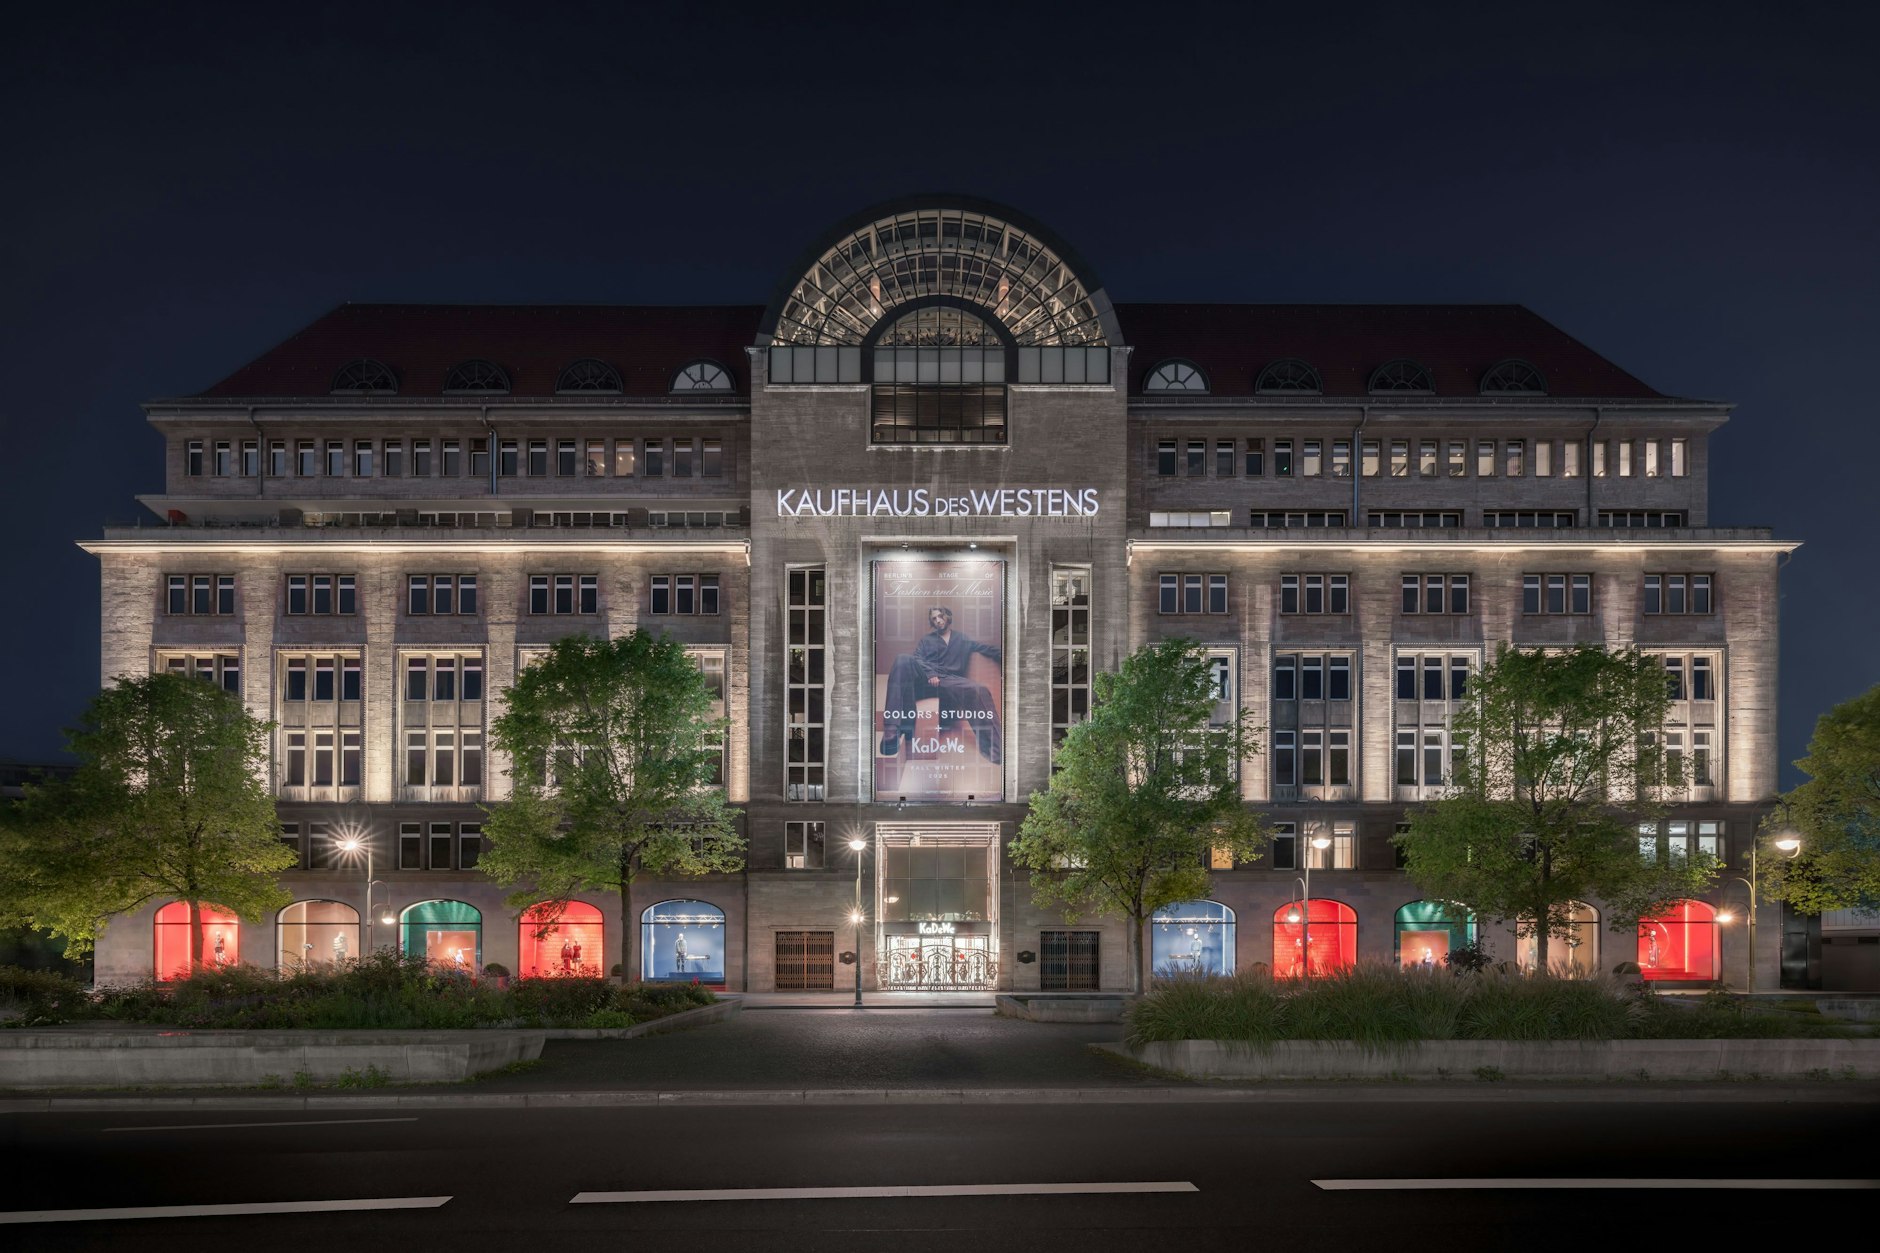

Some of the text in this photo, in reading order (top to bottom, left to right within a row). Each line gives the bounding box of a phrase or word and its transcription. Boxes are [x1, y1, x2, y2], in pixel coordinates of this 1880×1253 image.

[777, 488, 1099, 516] KAUFHAUS DES WESTENS
[884, 580, 993, 596] Fashion and Music
[883, 710, 994, 719] COLORS STUDIOS
[912, 738, 964, 753] KaDeWe
[919, 922, 955, 934] KaDeWe
